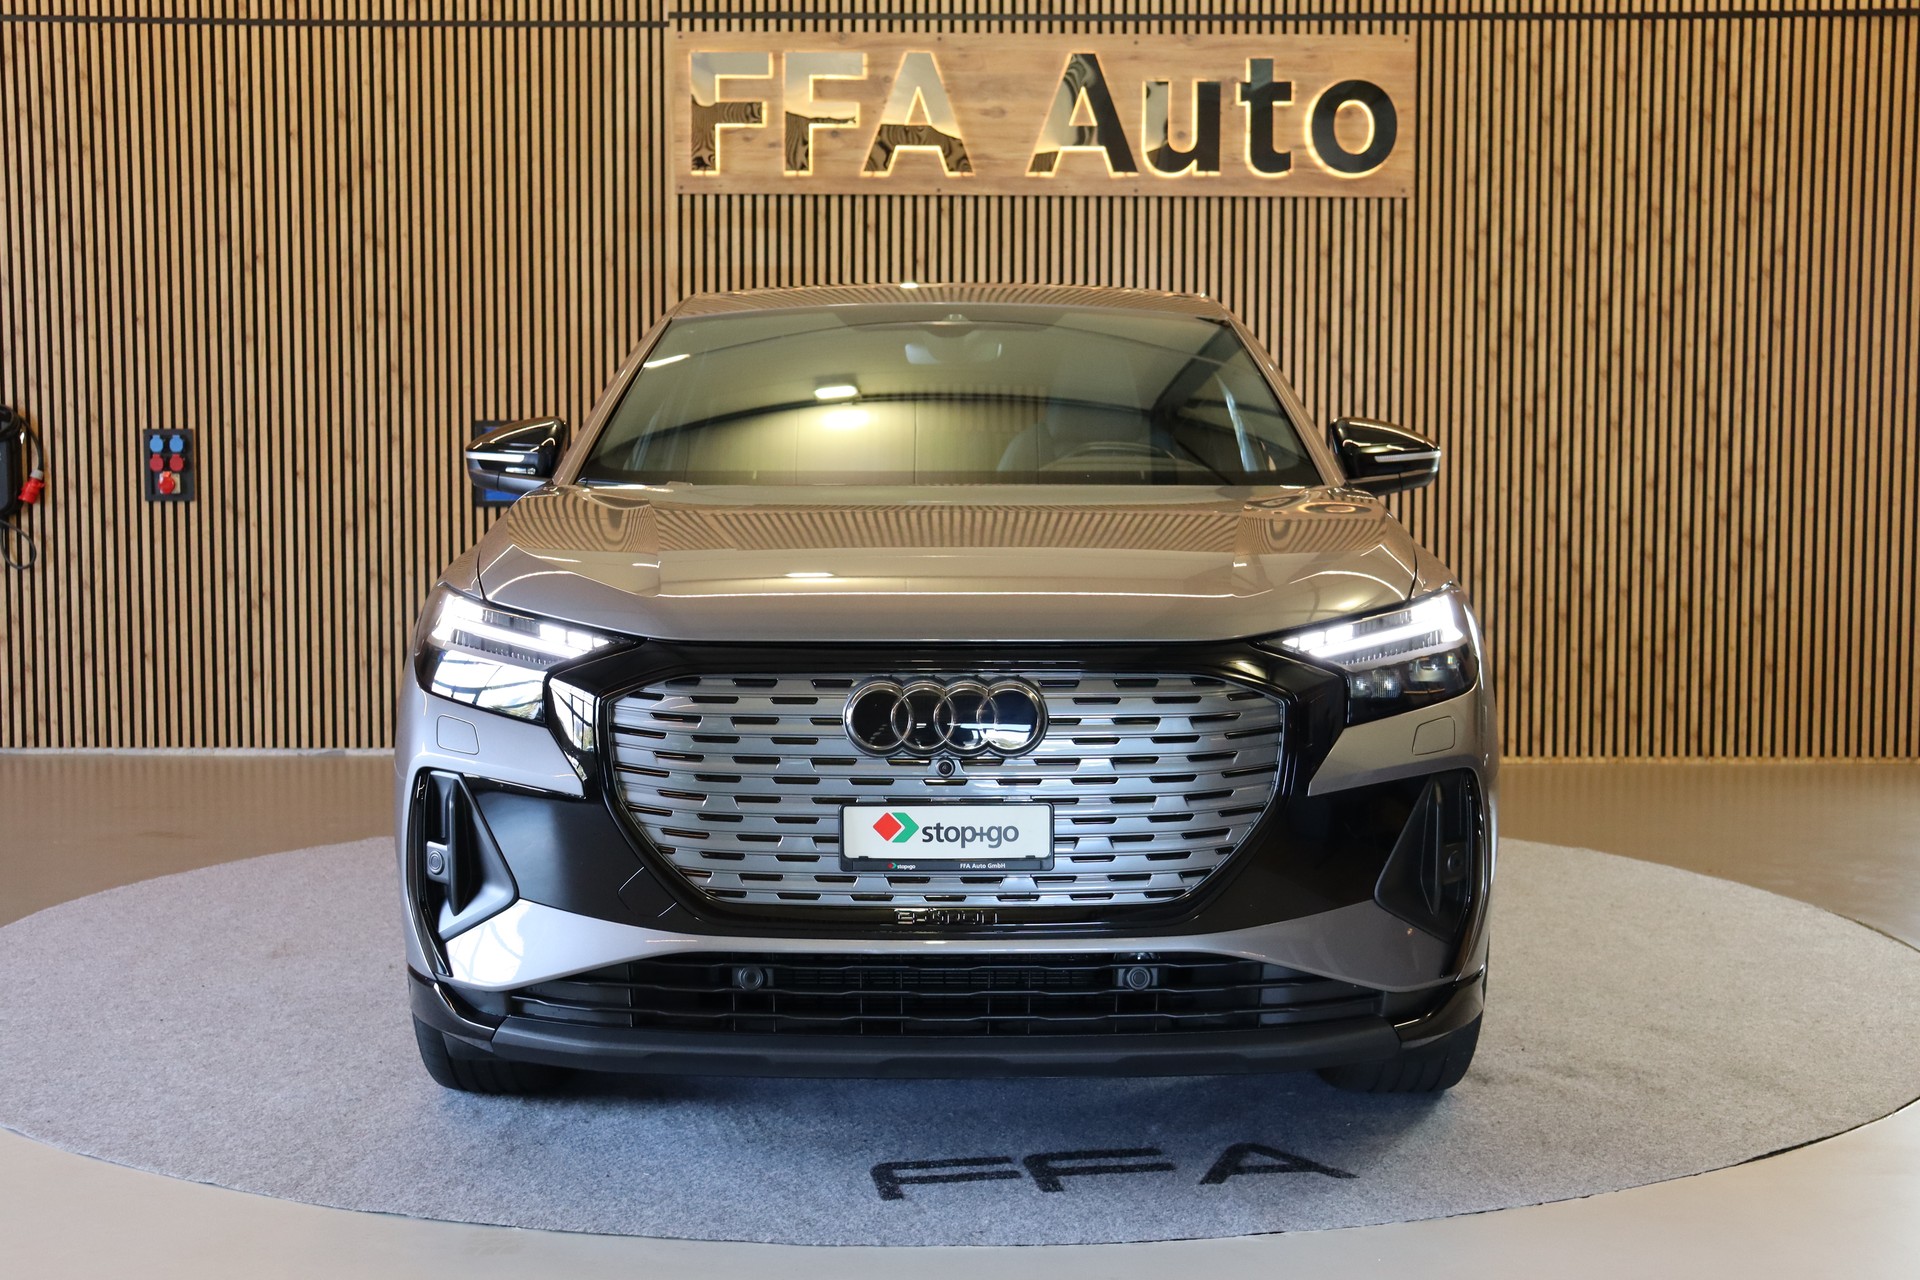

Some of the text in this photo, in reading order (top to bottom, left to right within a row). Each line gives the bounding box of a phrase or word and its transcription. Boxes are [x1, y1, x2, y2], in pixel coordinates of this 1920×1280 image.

[689, 50, 1400, 178] FFA Auto
[922, 822, 1019, 848] stop+go
[871, 1142, 1360, 1200] FFA
